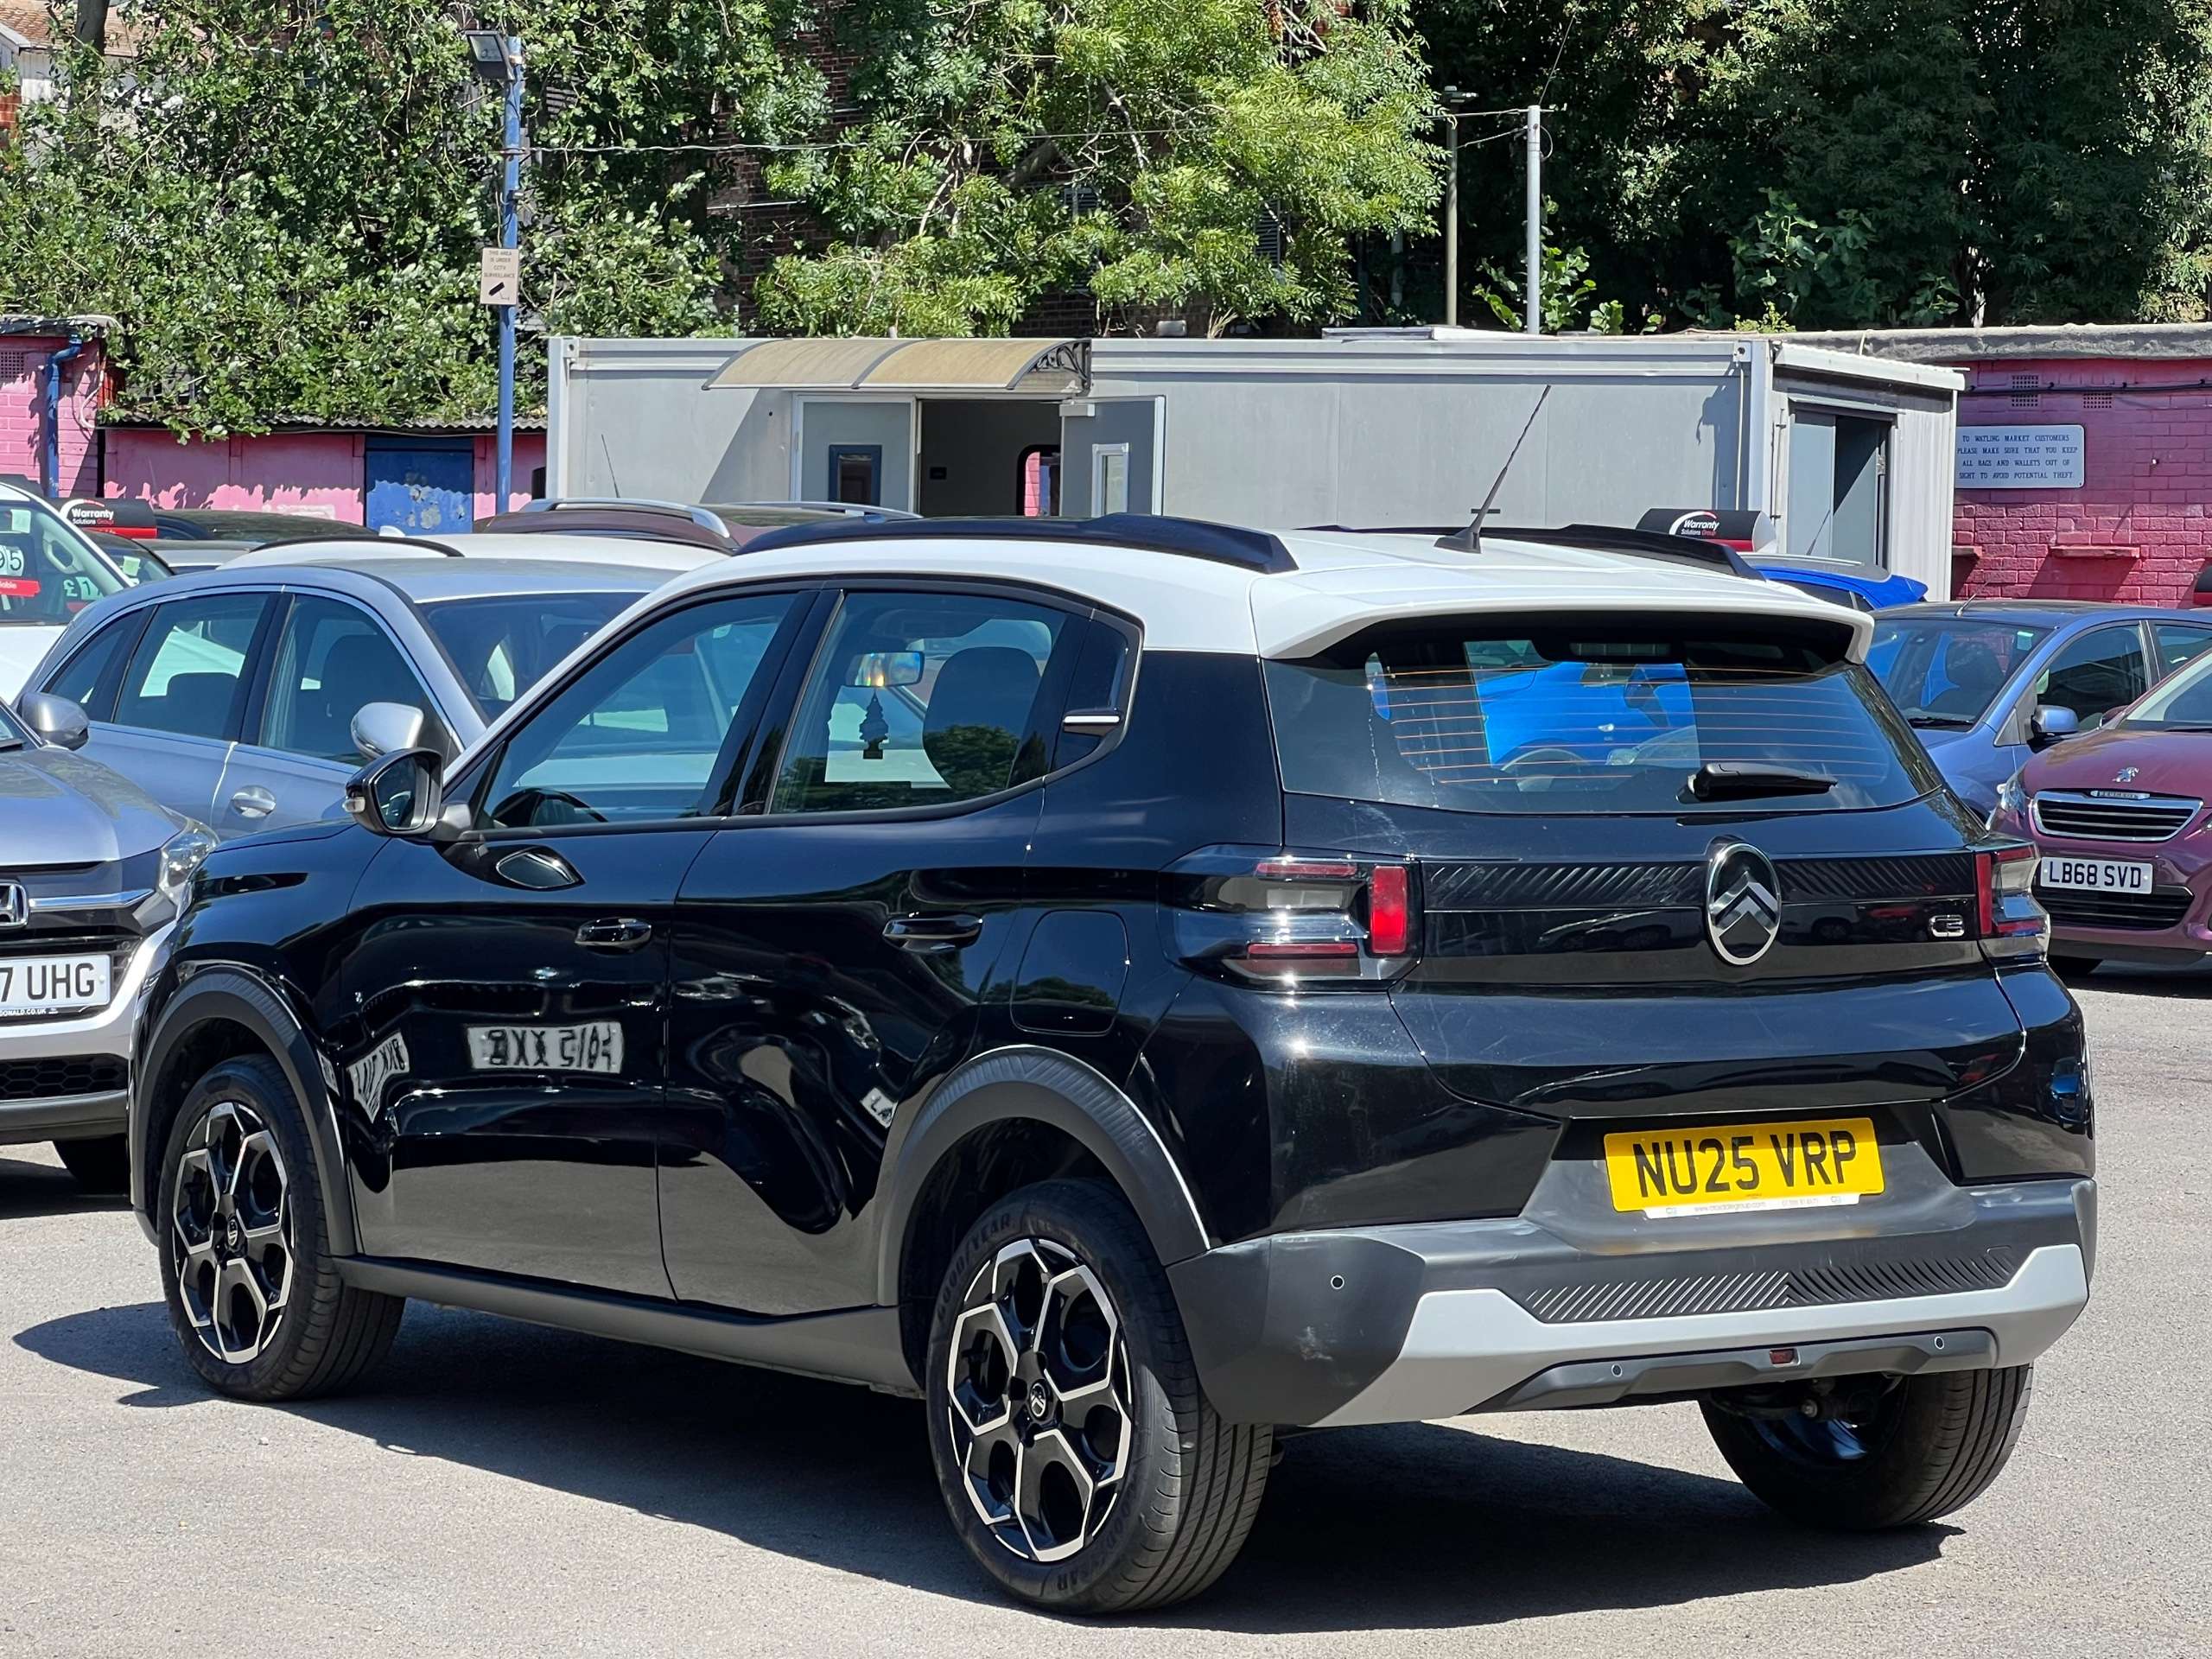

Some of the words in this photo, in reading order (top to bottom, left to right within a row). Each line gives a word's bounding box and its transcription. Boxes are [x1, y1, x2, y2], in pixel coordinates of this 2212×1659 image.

[72, 508, 114, 520] Warranty
[1684, 520, 1719, 531] Warranty
[2050, 861, 2098, 885] LB68
[2104, 866, 2141, 888] SVD
[0, 966, 14, 1002] 7
[28, 963, 94, 1000] UHG
[1633, 1135, 1759, 1198] NU25
[1770, 1130, 1857, 1187] VRP
